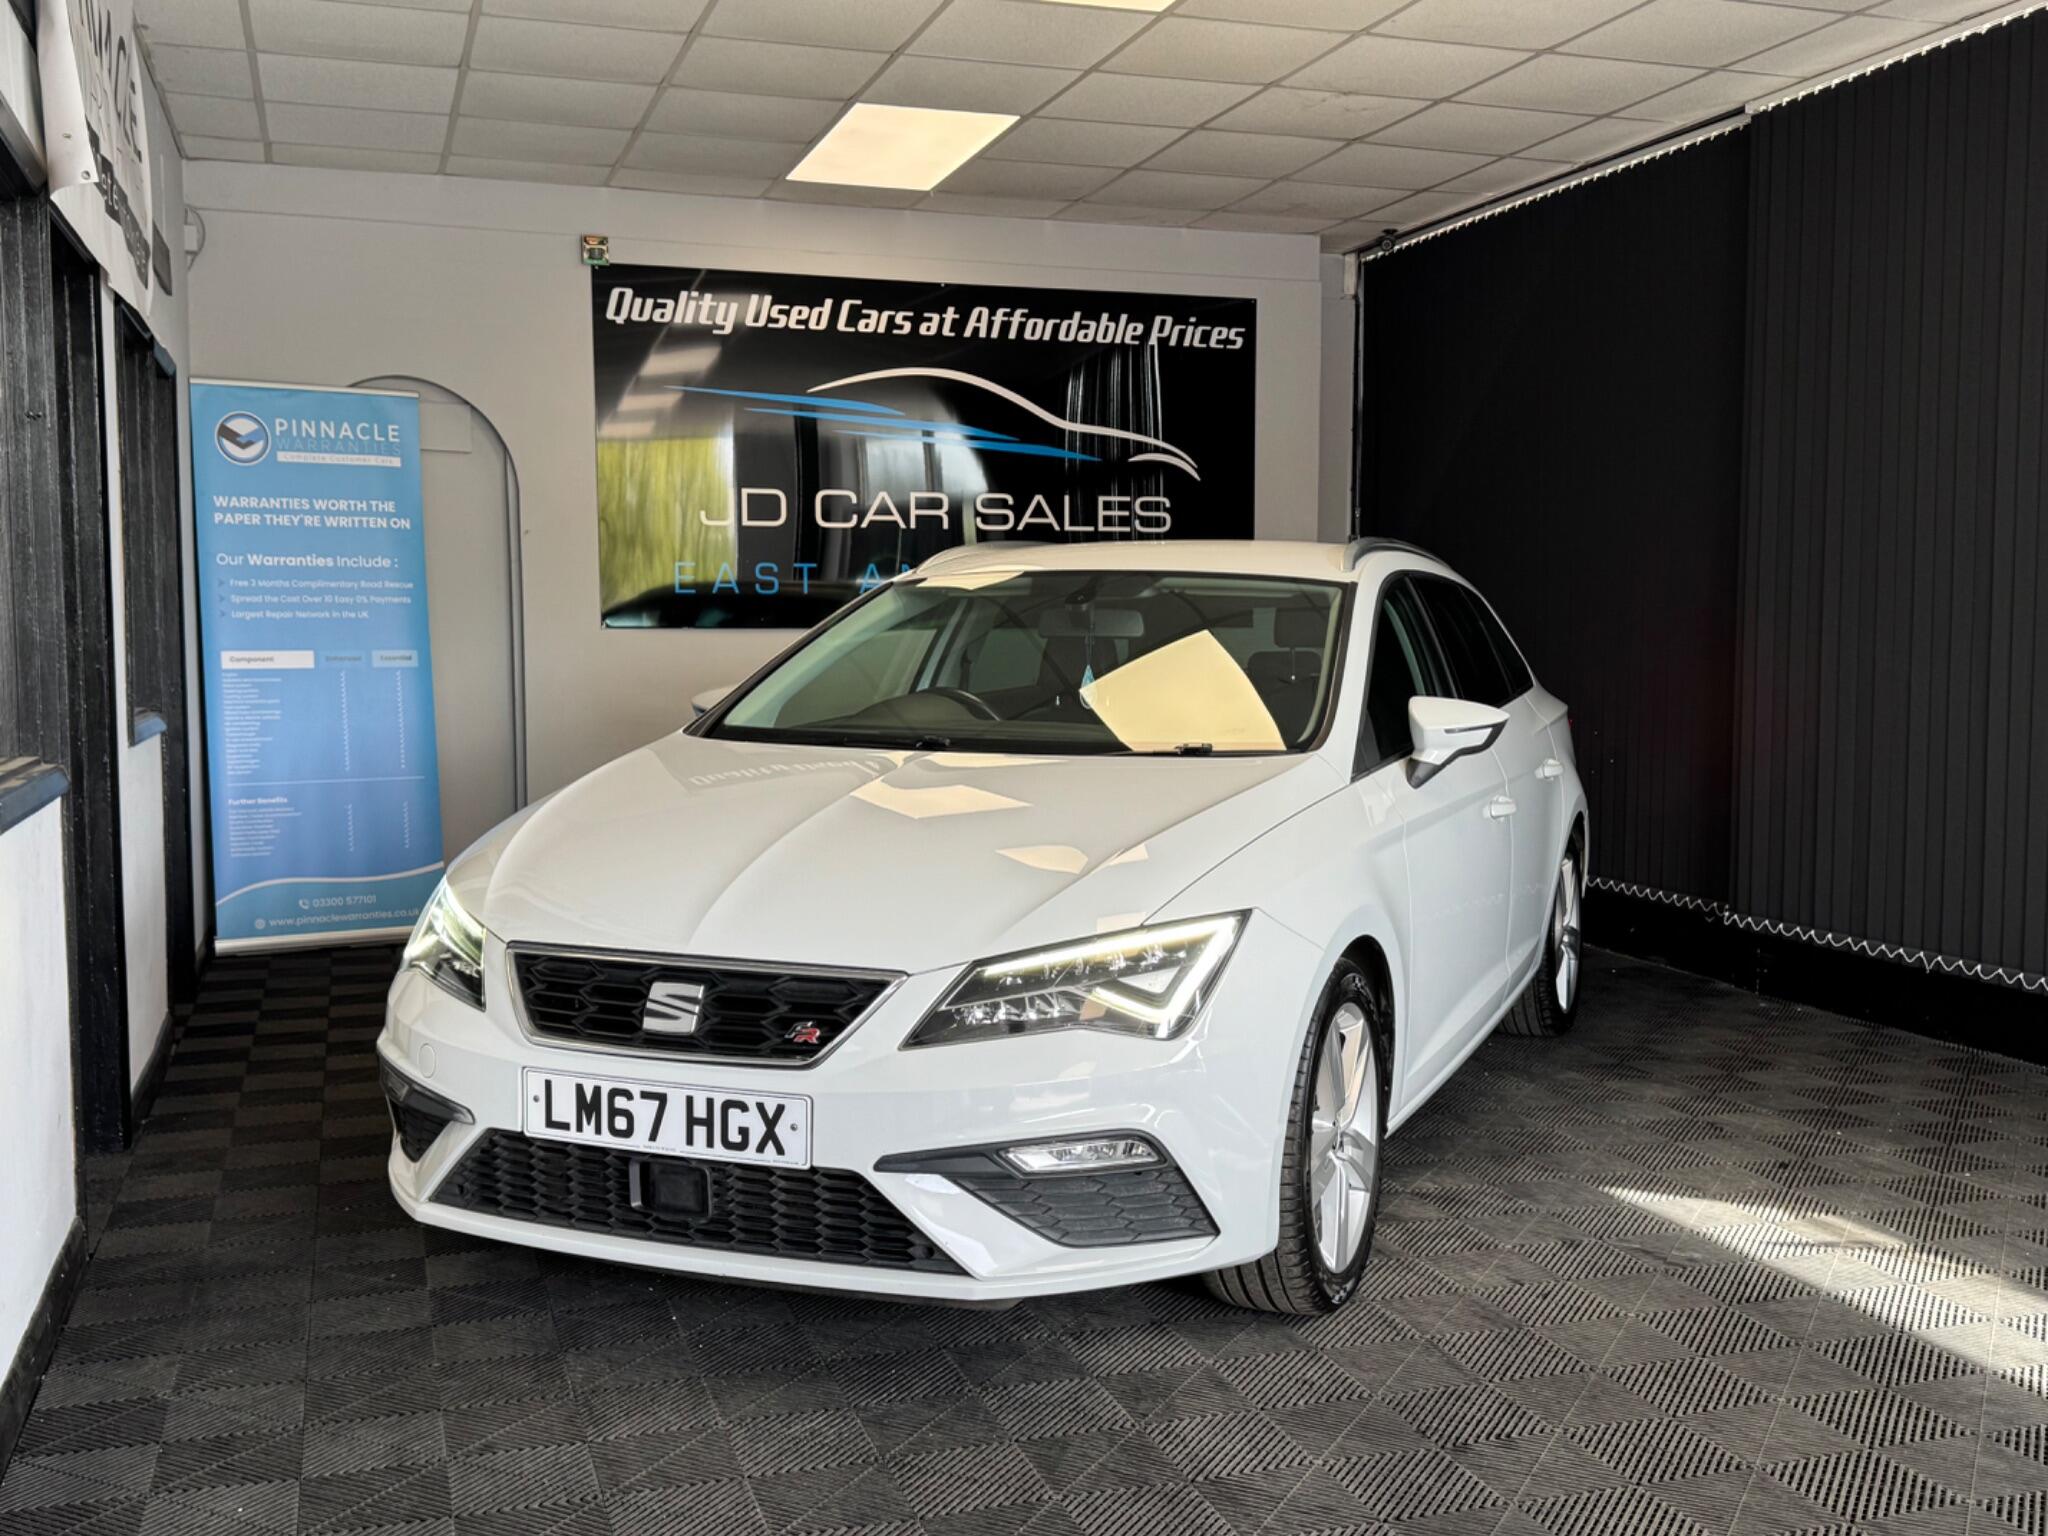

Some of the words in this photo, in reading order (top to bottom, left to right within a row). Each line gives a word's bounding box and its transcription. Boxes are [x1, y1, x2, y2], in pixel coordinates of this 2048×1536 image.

[606, 287, 738, 335] Quality
[745, 294, 833, 330] Used
[836, 299, 914, 335] Cars
[919, 306, 960, 337] at
[963, 307, 1144, 345] Affordable
[1149, 315, 1245, 349] Prices
[275, 418, 400, 442] PINNACLE
[213, 495, 309, 511] WARRANTIES
[313, 499, 367, 512] WORTH
[370, 500, 396, 513] THE
[700, 487, 787, 527] JD
[814, 489, 949, 530] CAR
[975, 493, 1172, 533] SALES
[214, 512, 260, 526] PAPER
[264, 513, 320, 527] THEY'RE
[324, 516, 387, 529] WRITTEN
[390, 517, 411, 530] ON
[216, 553, 244, 566] Our
[247, 553, 334, 567] Warranties
[674, 562, 817, 595] EAST
[231, 610, 264, 620] Largest
[229, 655, 275, 664] Component
[312, 896, 343, 908] 03300
[545, 1079, 667, 1142] LM67
[686, 1094, 785, 1156] HGX
